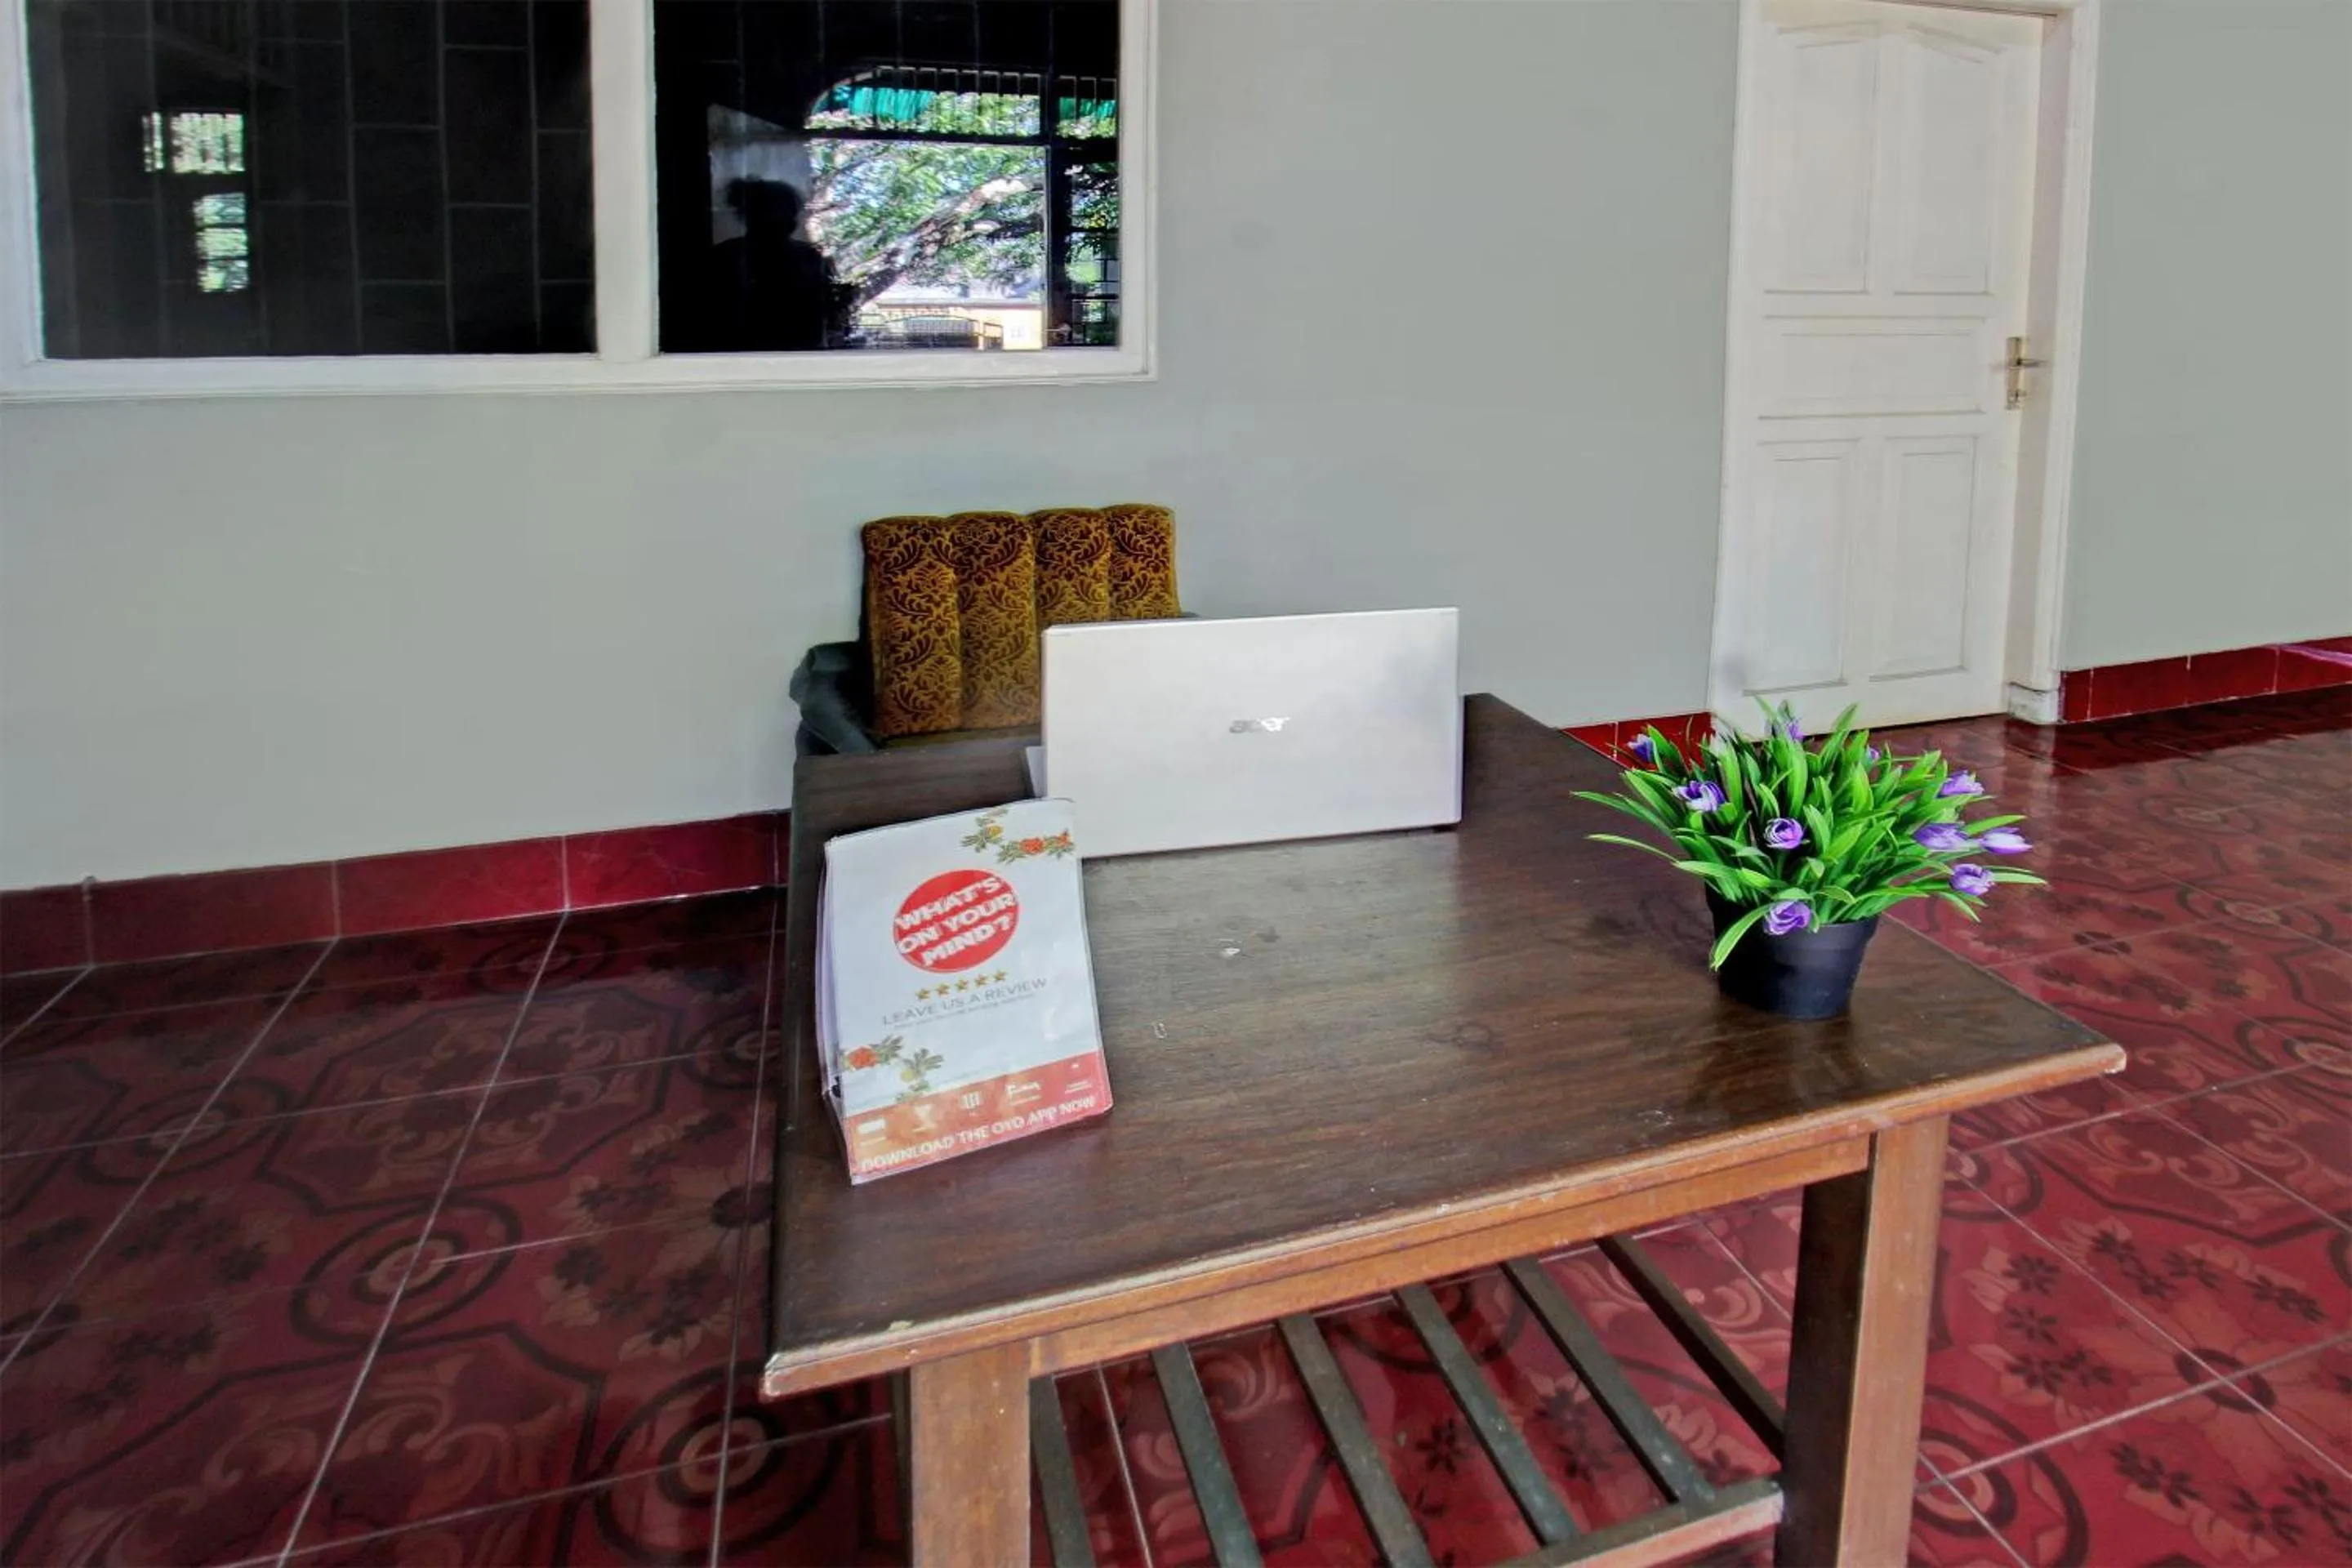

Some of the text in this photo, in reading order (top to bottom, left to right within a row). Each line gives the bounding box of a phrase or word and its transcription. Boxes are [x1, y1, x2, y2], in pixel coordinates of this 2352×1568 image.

[895, 876, 1002, 929] WHAT'S
[898, 893, 1016, 954] ON YOUR
[883, 1004, 937, 1026] LEAVE
[942, 998, 964, 1010] US
[965, 993, 981, 1004] A
[984, 978, 1046, 1001] REVIEW
[861, 1134, 954, 1170] DOWNLOAD
[956, 1125, 989, 1144] THE
[991, 1116, 1022, 1134] OYO
[1026, 1107, 1058, 1126] APP
[1059, 1096, 1095, 1116] NOW
